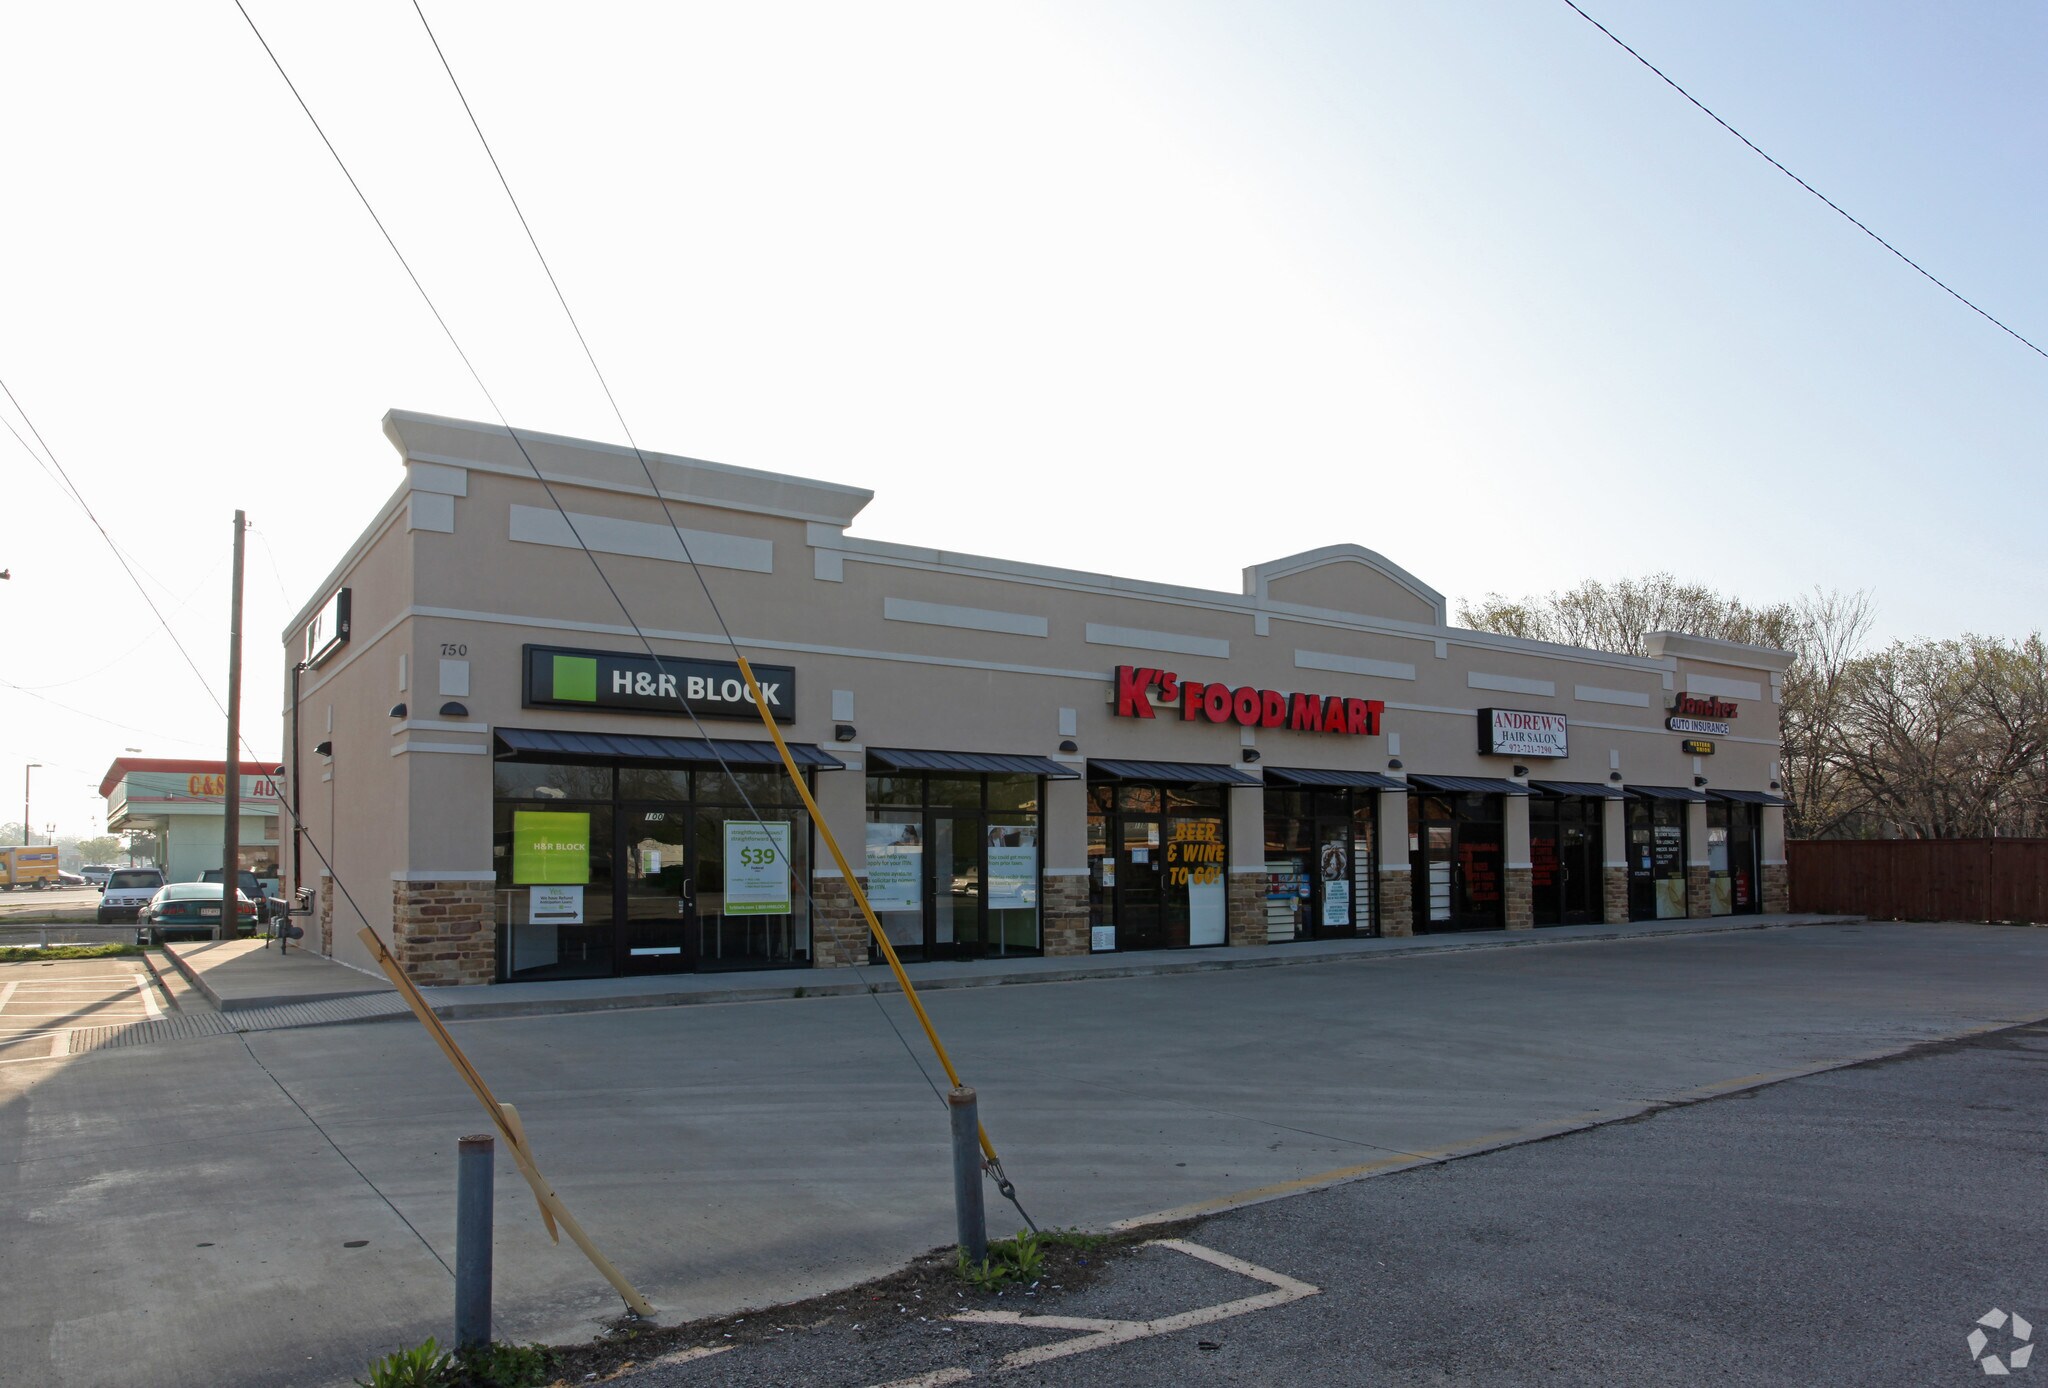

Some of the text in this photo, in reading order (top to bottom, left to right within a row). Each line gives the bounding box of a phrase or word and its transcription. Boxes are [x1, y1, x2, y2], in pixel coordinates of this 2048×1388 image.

[440, 643, 468, 656] 750
[612, 670, 781, 705] H&R BLOCK
[1179, 681, 1287, 728] FOOD
[1286, 692, 1385, 736] MART
[1675, 691, 1738, 718] Sanchez
[1494, 712, 1565, 732] ANDREW'S
[1671, 718, 1728, 734] AUTO INSURANCE
[1502, 730, 1557, 744] HAIR SALON
[1508, 743, 1552, 754] 972-721-7290
[1175, 823, 1216, 842] BEER
[740, 846, 775, 867] $39
[1167, 844, 1178, 862] &
[1183, 844, 1225, 863] WINE
[1169, 866, 1221, 886] TO GO!
